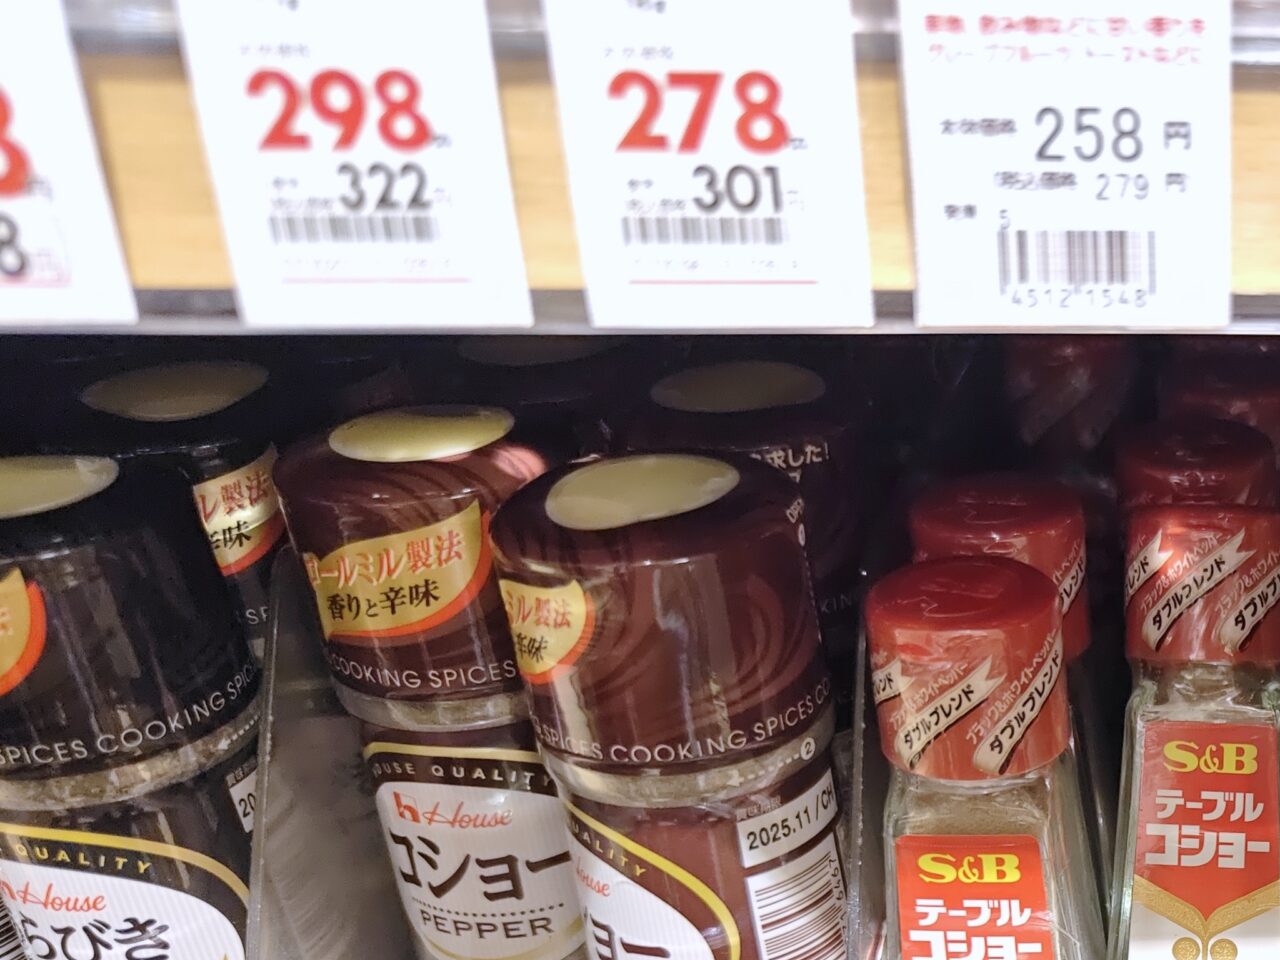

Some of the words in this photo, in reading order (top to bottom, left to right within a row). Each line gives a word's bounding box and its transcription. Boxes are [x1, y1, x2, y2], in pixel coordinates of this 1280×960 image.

[246, 68, 431, 152] 298
[607, 70, 790, 154] 278
[1035, 106, 1143, 162] 258
[338, 162, 431, 211] 322
[692, 165, 783, 214] 301
[1095, 173, 1149, 200] 279
[326, 577, 441, 622] 香りと辛味
[331, 652, 422, 687] COOKING
[429, 660, 518, 690] SPICES
[97, 690, 226, 753] COOKING
[903, 684, 975, 750] ダブルブレンド
[990, 651, 1061, 754] ダブルブレンド
[610, 728, 747, 765] COOKING
[753, 697, 814, 742] SPICES
[1163, 740, 1258, 775] S&B
[422, 800, 512, 830] House
[1155, 789, 1265, 823] テーブル
[15, 843, 152, 874] QUALITY
[388, 827, 573, 901] コショー
[570, 822, 647, 878] UALITY
[916, 853, 1022, 884] S&B
[1145, 823, 1271, 869] コショー
[420, 909, 555, 940] PEPPER
[914, 899, 1032, 927] テーブル
